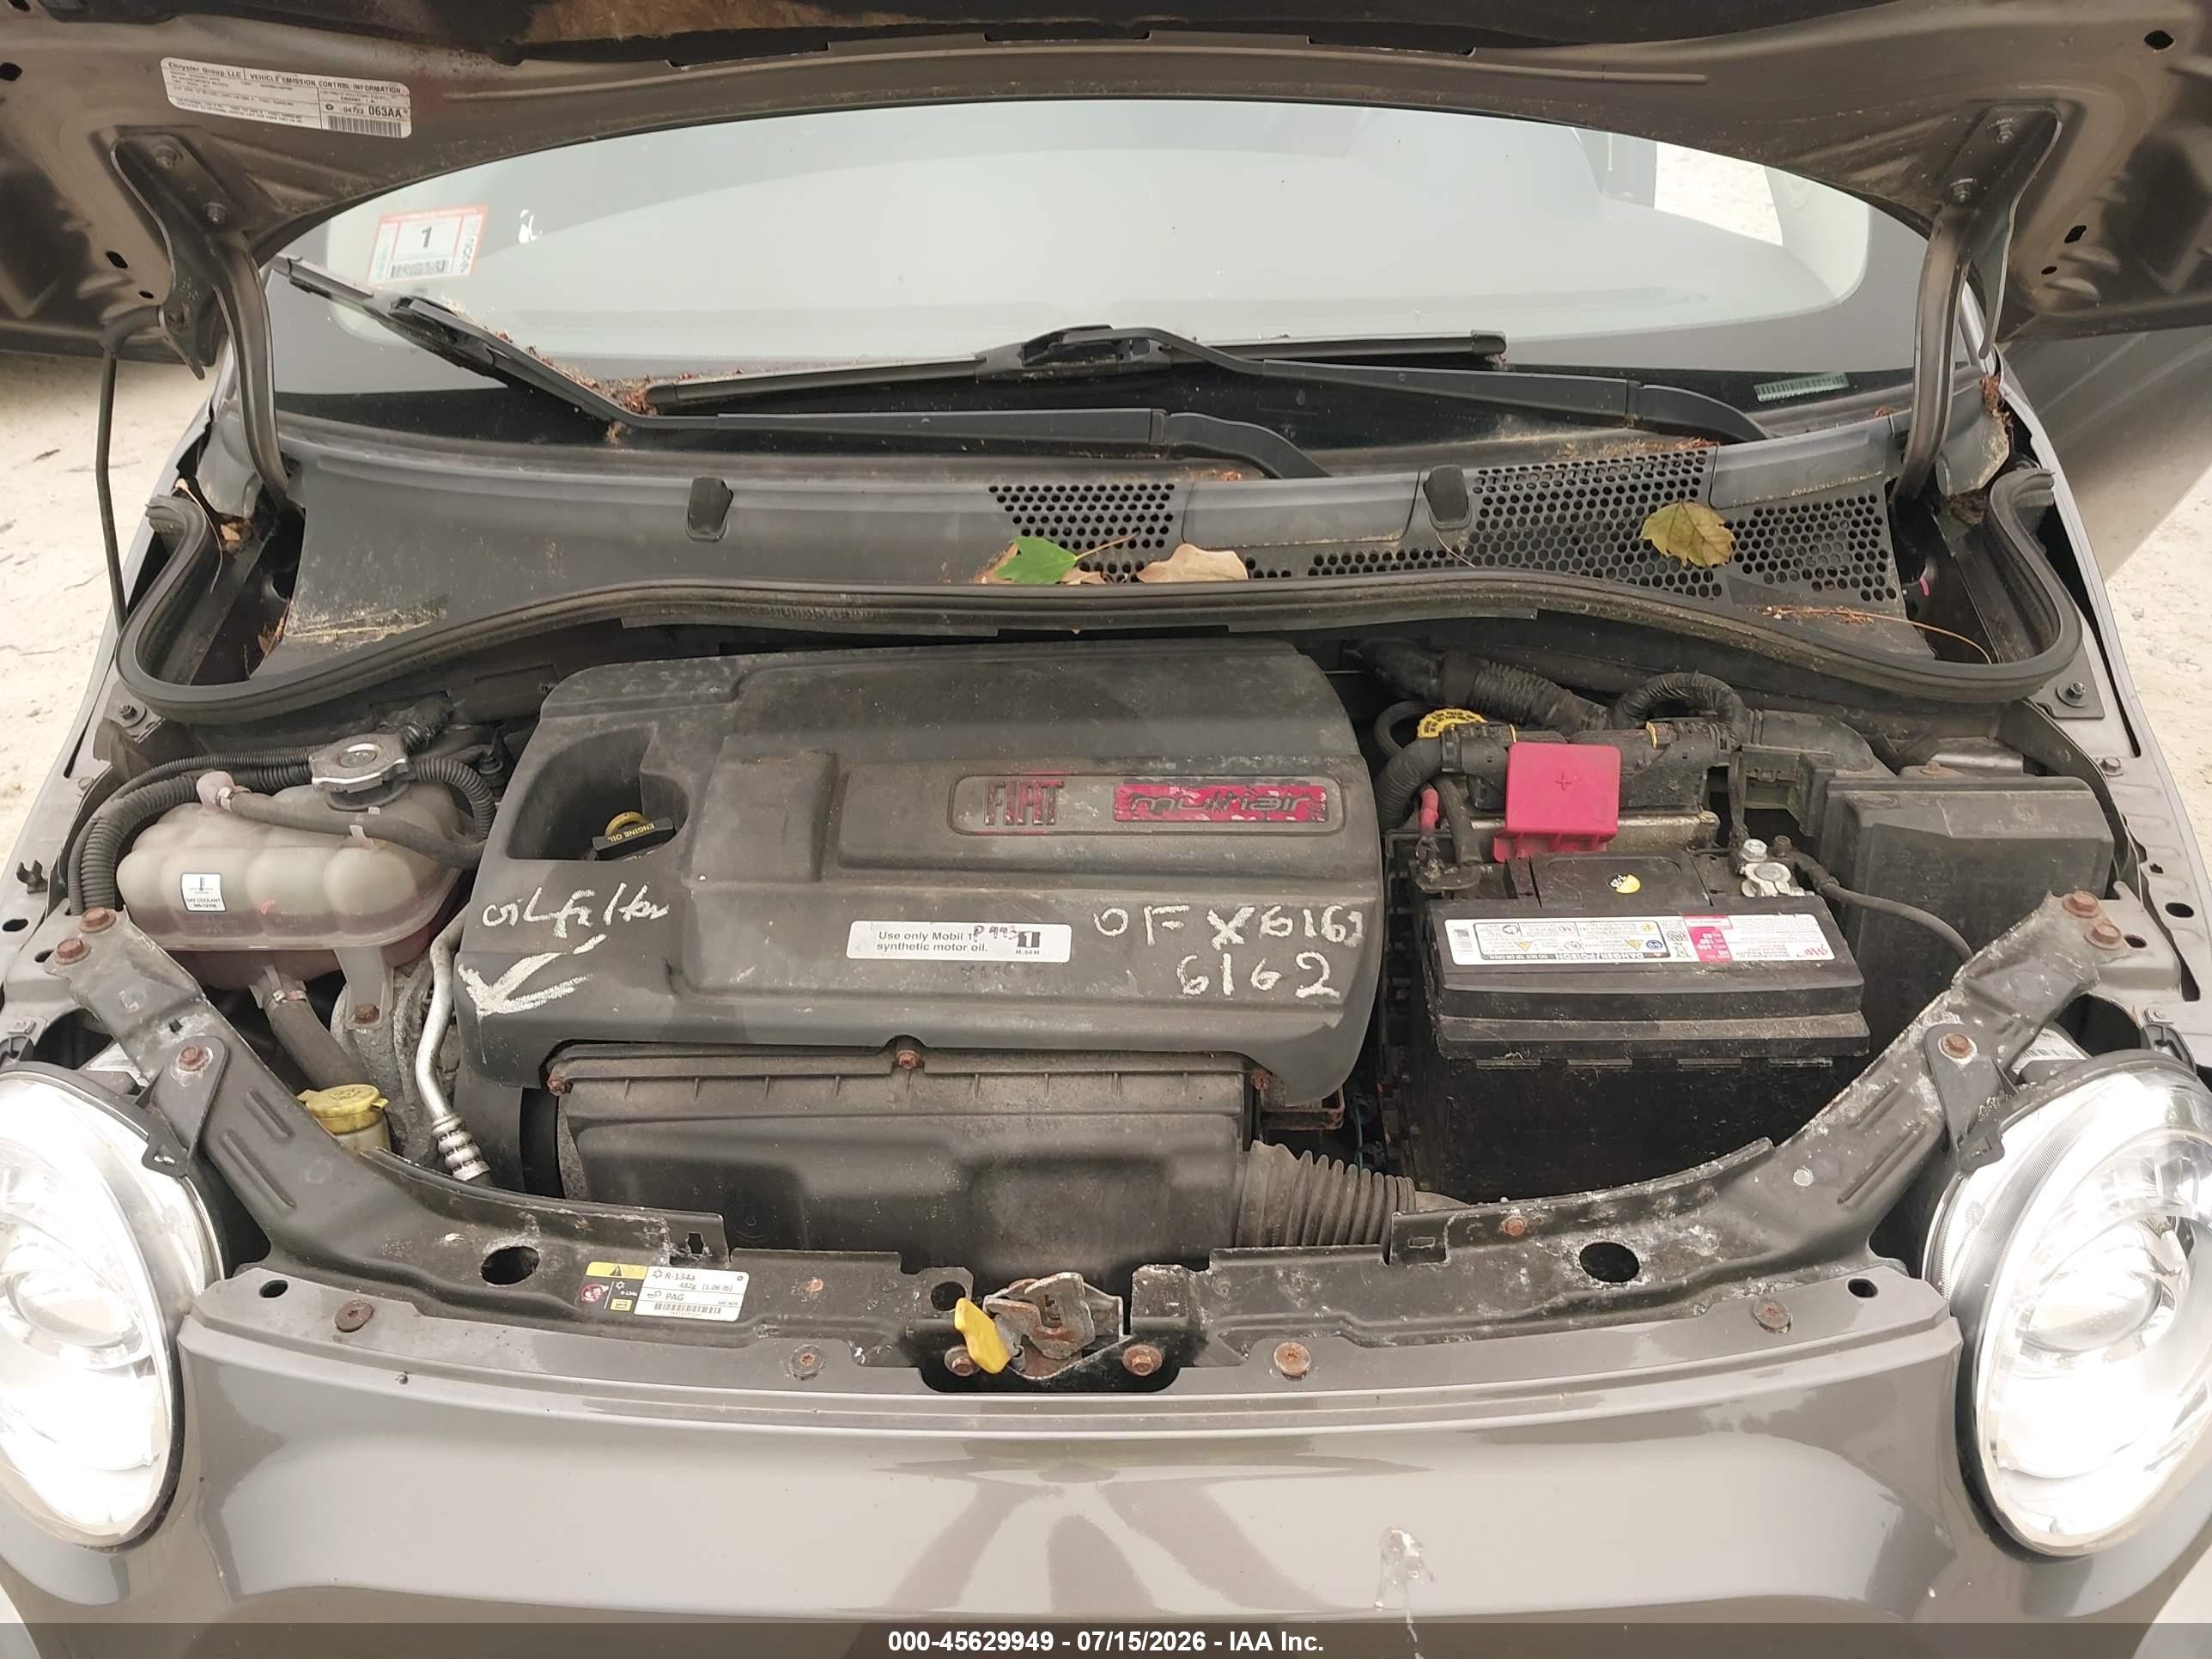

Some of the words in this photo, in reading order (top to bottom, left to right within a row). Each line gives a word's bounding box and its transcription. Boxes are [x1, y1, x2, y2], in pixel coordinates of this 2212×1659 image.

[168, 62, 200, 73] Chrysler
[203, 67, 225, 76] Group
[227, 70, 241, 78] LLC
[250, 73, 281, 82] VEHICLE
[282, 76, 316, 87] EMISSION
[319, 81, 351, 90] CONTROL
[352, 82, 401, 94] INFORMATION
[368, 105, 403, 118] 063AA
[421, 226, 433, 248] 1
[983, 779, 1066, 826] FIAT
[1128, 792, 1310, 813] multiair
[607, 833, 623, 843] OIL
[623, 823, 655, 838] ENGINE
[1093, 905, 1191, 946] OF
[878, 931, 901, 941] Use
[903, 931, 929, 943] only
[932, 932, 963, 942] Mobil
[876, 942, 930, 952] synthetic
[933, 943, 968, 952] motor
[970, 943, 988, 952] oil.
[1176, 951, 1341, 999] 6162
[664, 1272, 696, 1281] R-134a
[665, 1292, 685, 1302] PAG
